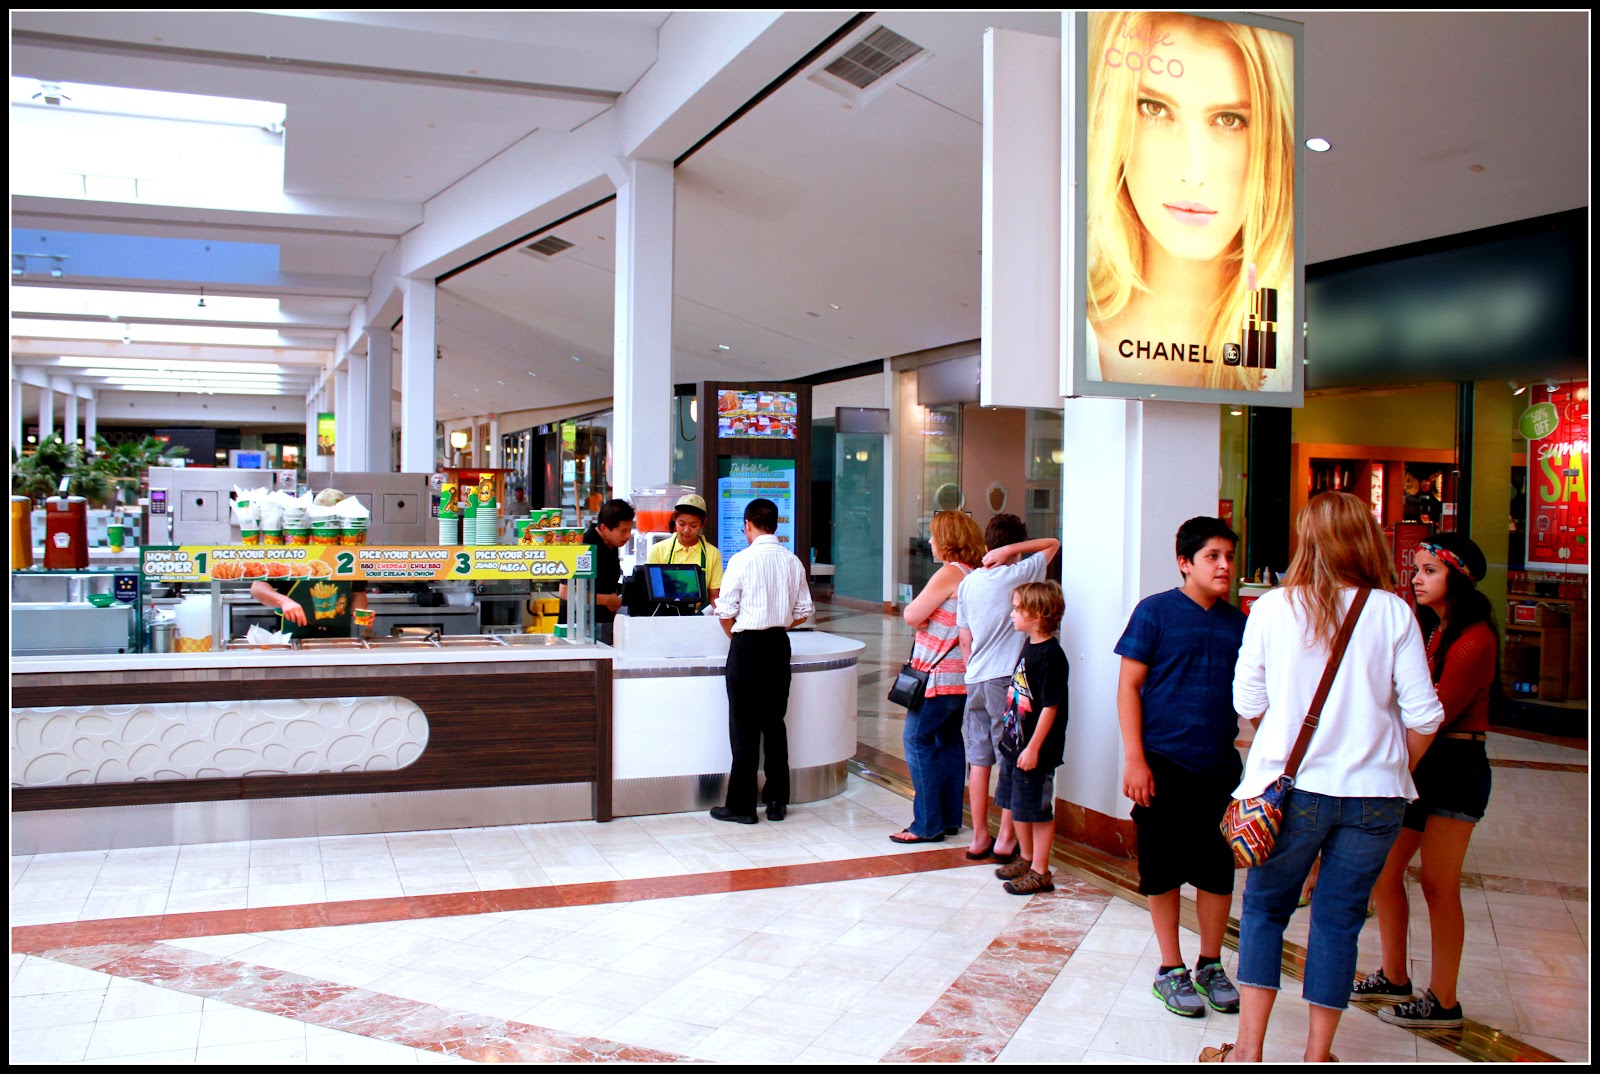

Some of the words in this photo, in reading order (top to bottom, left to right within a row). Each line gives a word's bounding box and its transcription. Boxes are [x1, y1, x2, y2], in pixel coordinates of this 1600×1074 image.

[1105, 47, 1184, 78] COCO
[1118, 339, 1214, 363] CHANEL
[1534, 419, 1549, 436] OFF
[147, 552, 171, 561] HOW
[173, 552, 188, 561] TO
[212, 550, 235, 559] PICK
[237, 550, 265, 559] YOUR
[267, 550, 306, 559] POTATO
[359, 551, 382, 559] PICK
[384, 551, 409, 559] YOUR
[411, 551, 448, 559] FLAVOR
[475, 551, 497, 559] PICK
[498, 551, 523, 559] YOUR
[524, 551, 546, 559] SIZE
[145, 562, 192, 573] ORDER
[194, 553, 206, 573] 1
[337, 552, 354, 574] 2
[455, 553, 471, 574] 3
[499, 563, 527, 571] MEGA
[532, 562, 568, 574] GIGA
